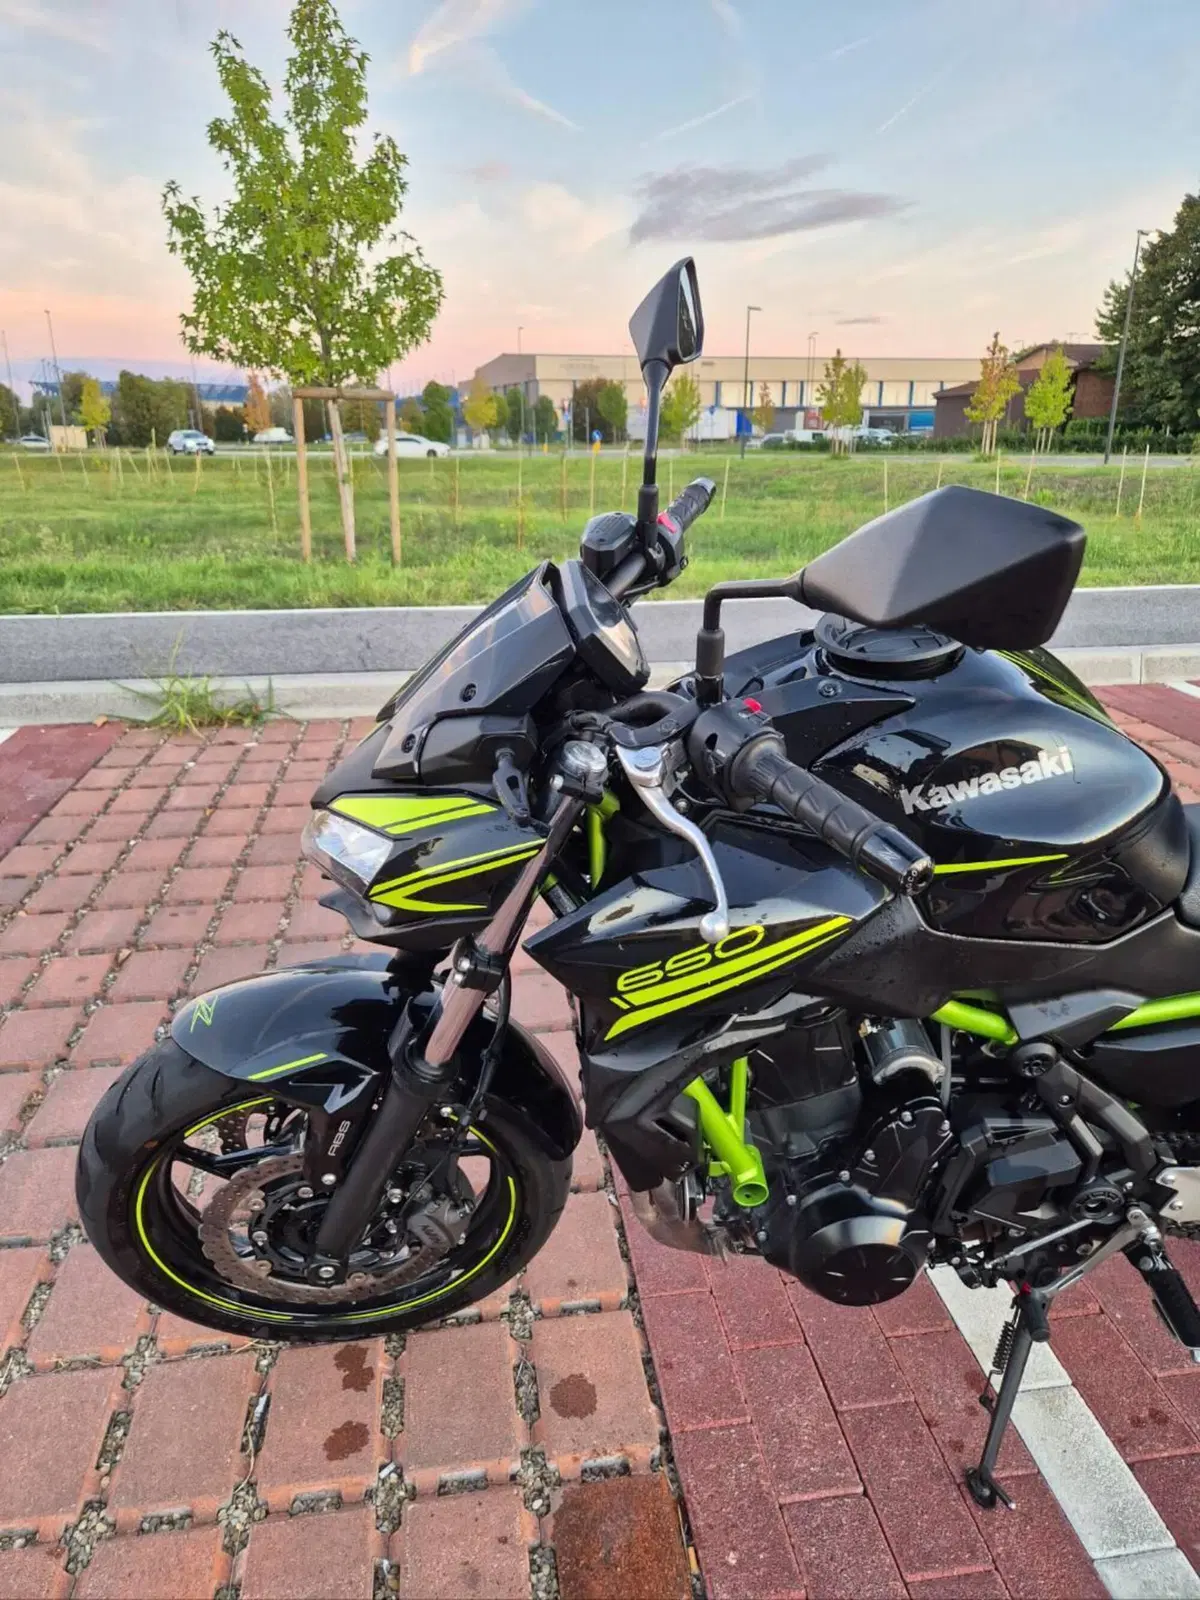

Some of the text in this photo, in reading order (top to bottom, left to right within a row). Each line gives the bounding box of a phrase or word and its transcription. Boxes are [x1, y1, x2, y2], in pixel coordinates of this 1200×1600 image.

[900, 745, 1074, 815] Kawasaki
[617, 924, 766, 992] 650
[328, 1120, 351, 1156] ABS
